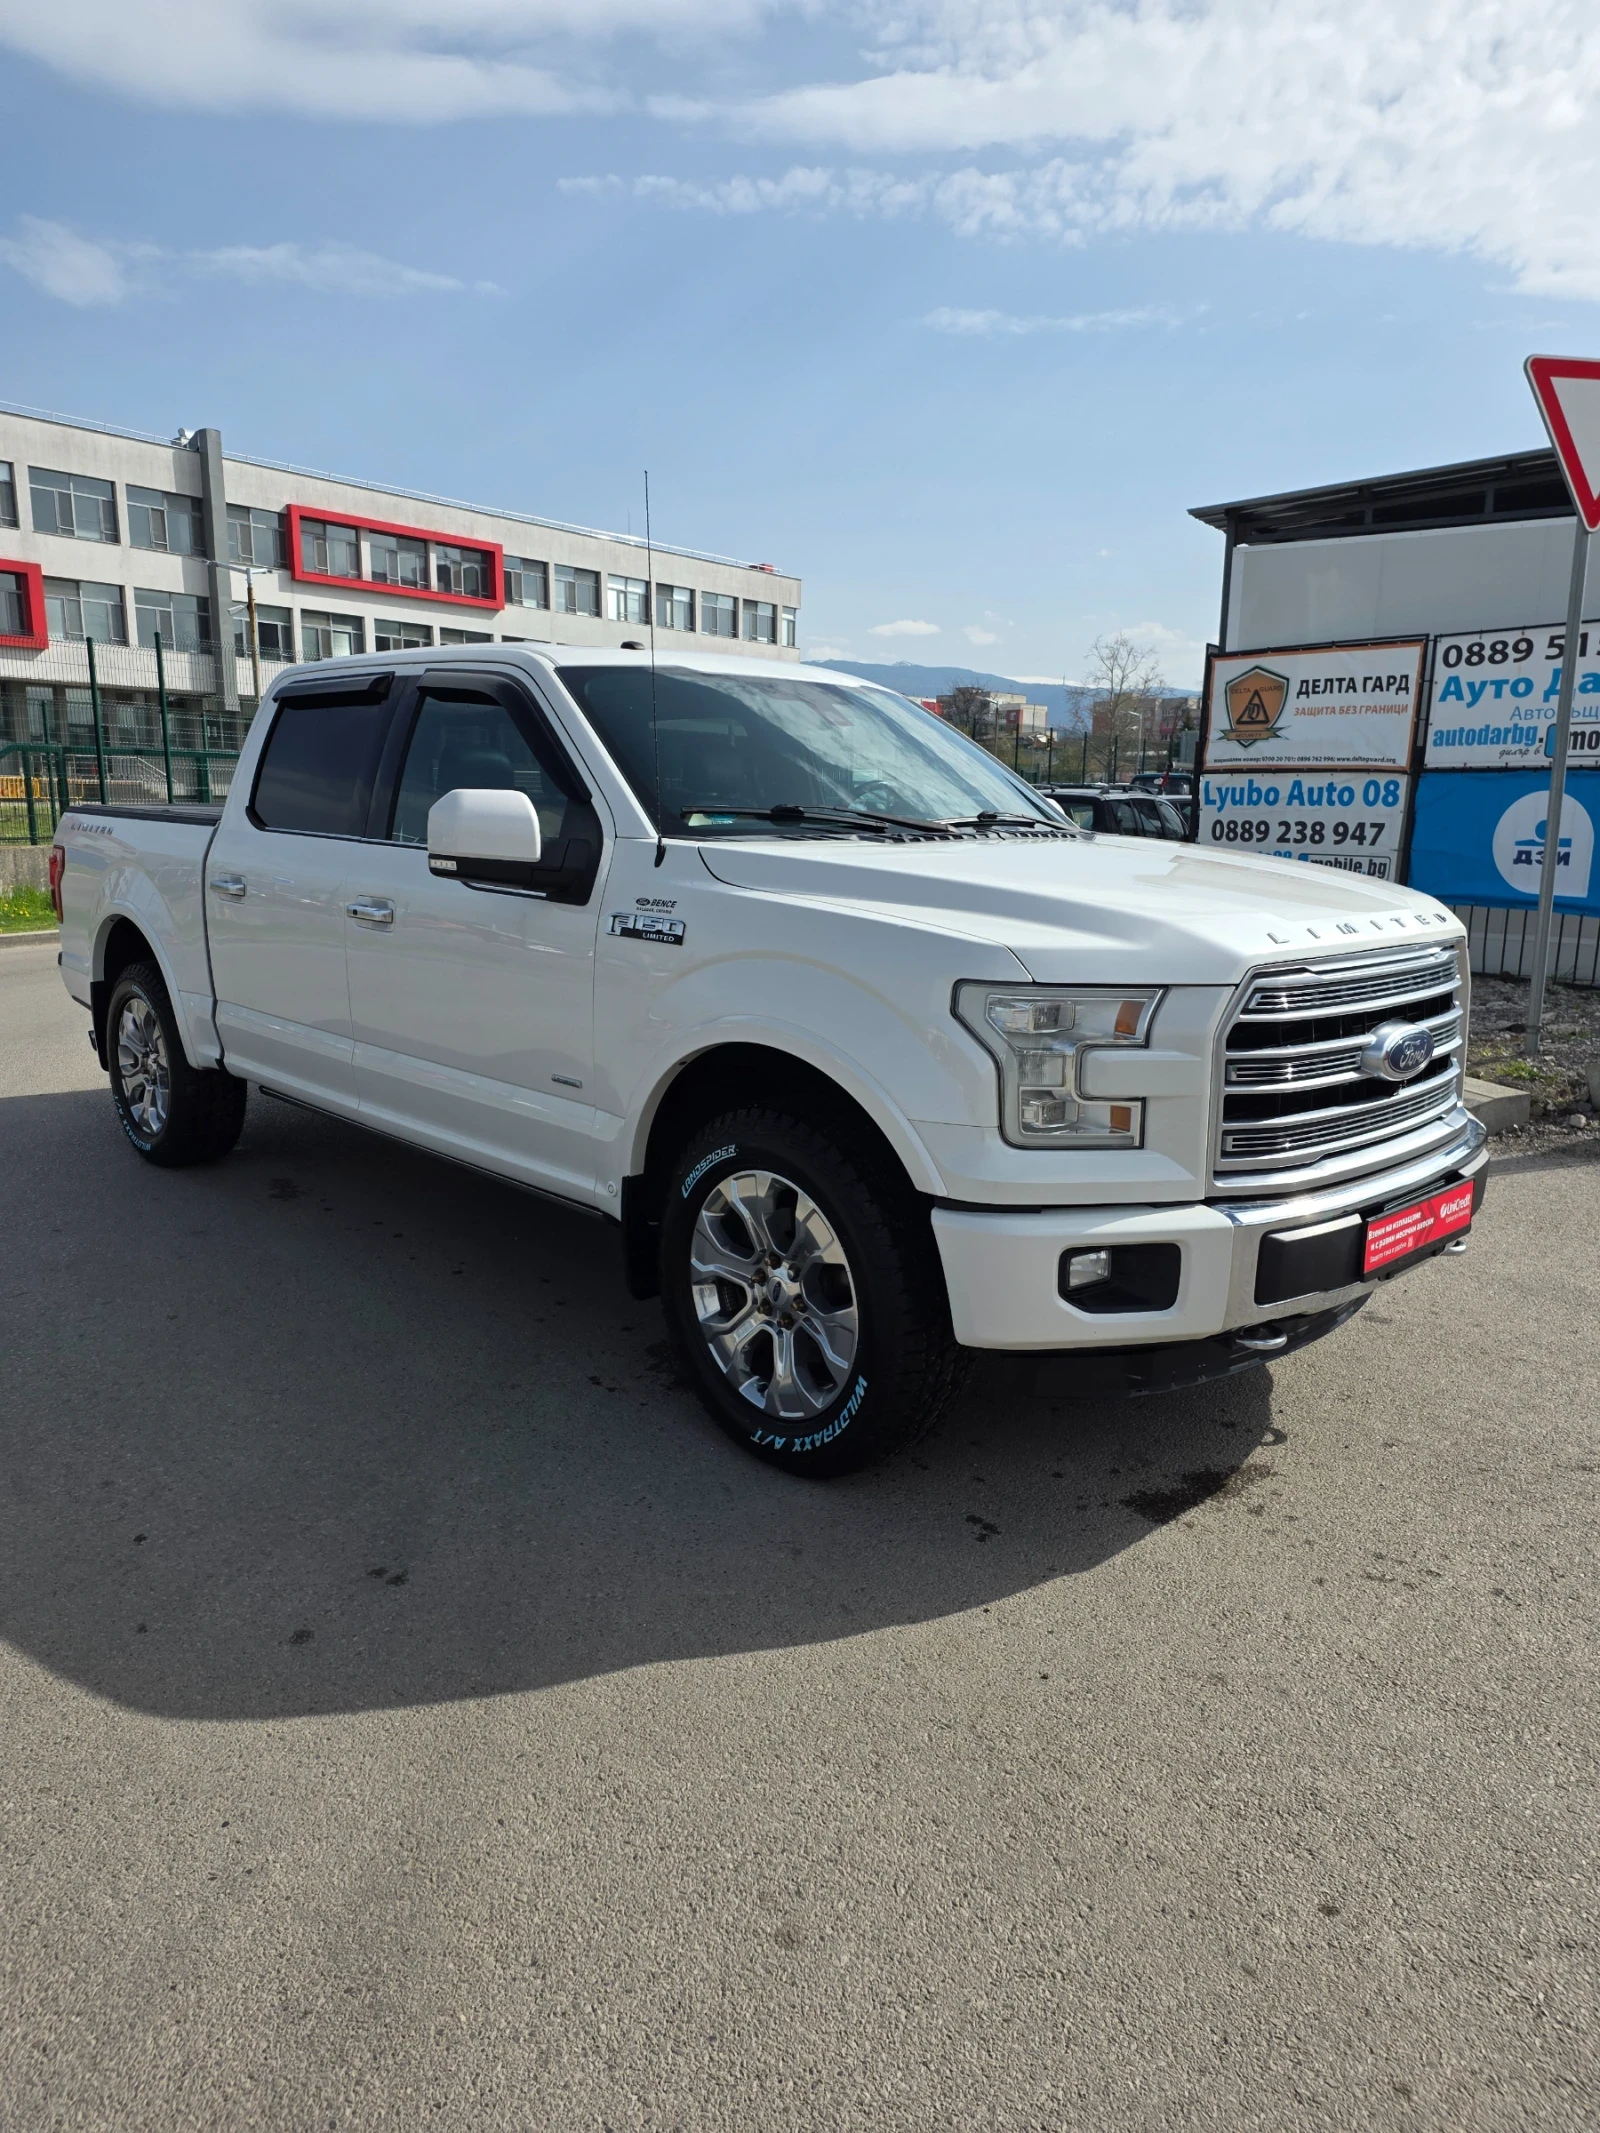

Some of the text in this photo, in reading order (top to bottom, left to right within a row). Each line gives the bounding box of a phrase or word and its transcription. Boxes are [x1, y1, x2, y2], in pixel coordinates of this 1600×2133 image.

[1442, 632, 1600, 669] 0889 51
[1230, 685, 1283, 695] DELTA GUARD
[1296, 674, 1410, 699] ДЕЛТА ГАРД
[1438, 671, 1534, 709] Ауто
[1293, 703, 1409, 718] ЗАЩИТА БЕЗ ГРАНИЦИ
[1509, 705, 1599, 721] Автоъщ
[1336, 756, 1397, 764] www.deltaguard.org
[1203, 779, 1400, 813] Lyubo Auto 08
[70, 822, 115, 836] LIMITED
[1211, 819, 1386, 846] 0889 238 947
[650, 899, 678, 909] BENCE
[642, 932, 675, 942] LIMITED
[1266, 913, 1447, 944] LIMITED
[1400, 1039, 1428, 1066] Ford
[1447, 1193, 1471, 1215] UniCredit
[750, 1375, 868, 1452] WILDTRAXX A/T
